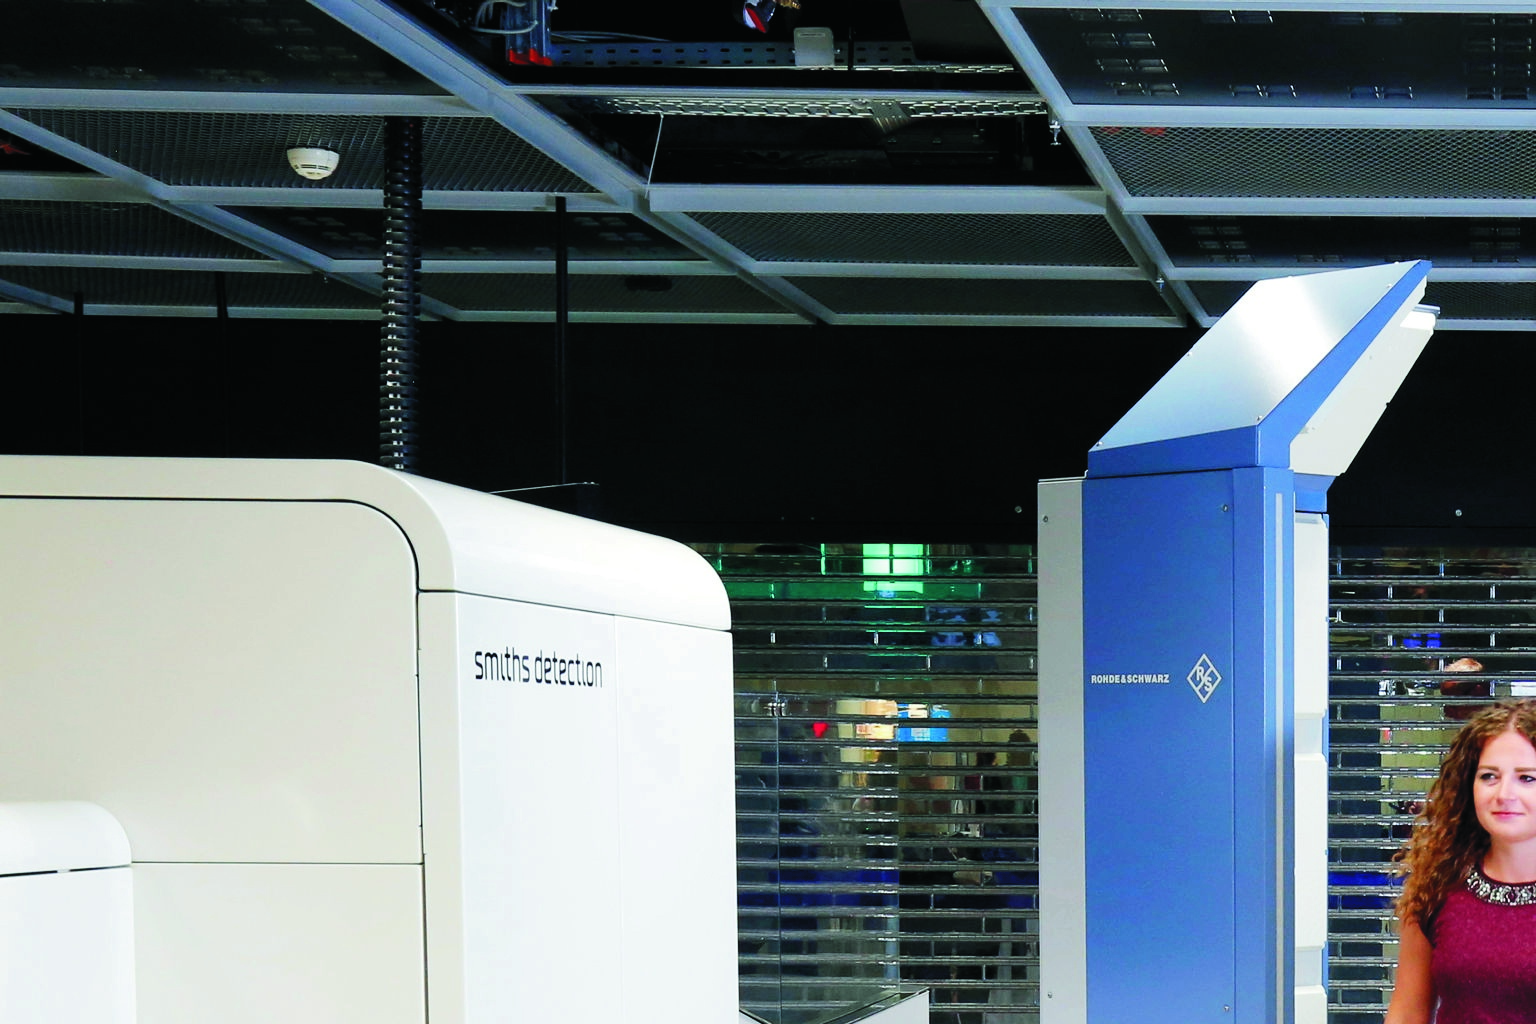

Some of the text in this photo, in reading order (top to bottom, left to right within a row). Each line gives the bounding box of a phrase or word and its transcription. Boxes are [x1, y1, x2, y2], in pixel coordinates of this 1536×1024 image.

[474, 646, 603, 688] smiths detection
[1091, 674, 1170, 684] ROHDE&SCHWARZ
